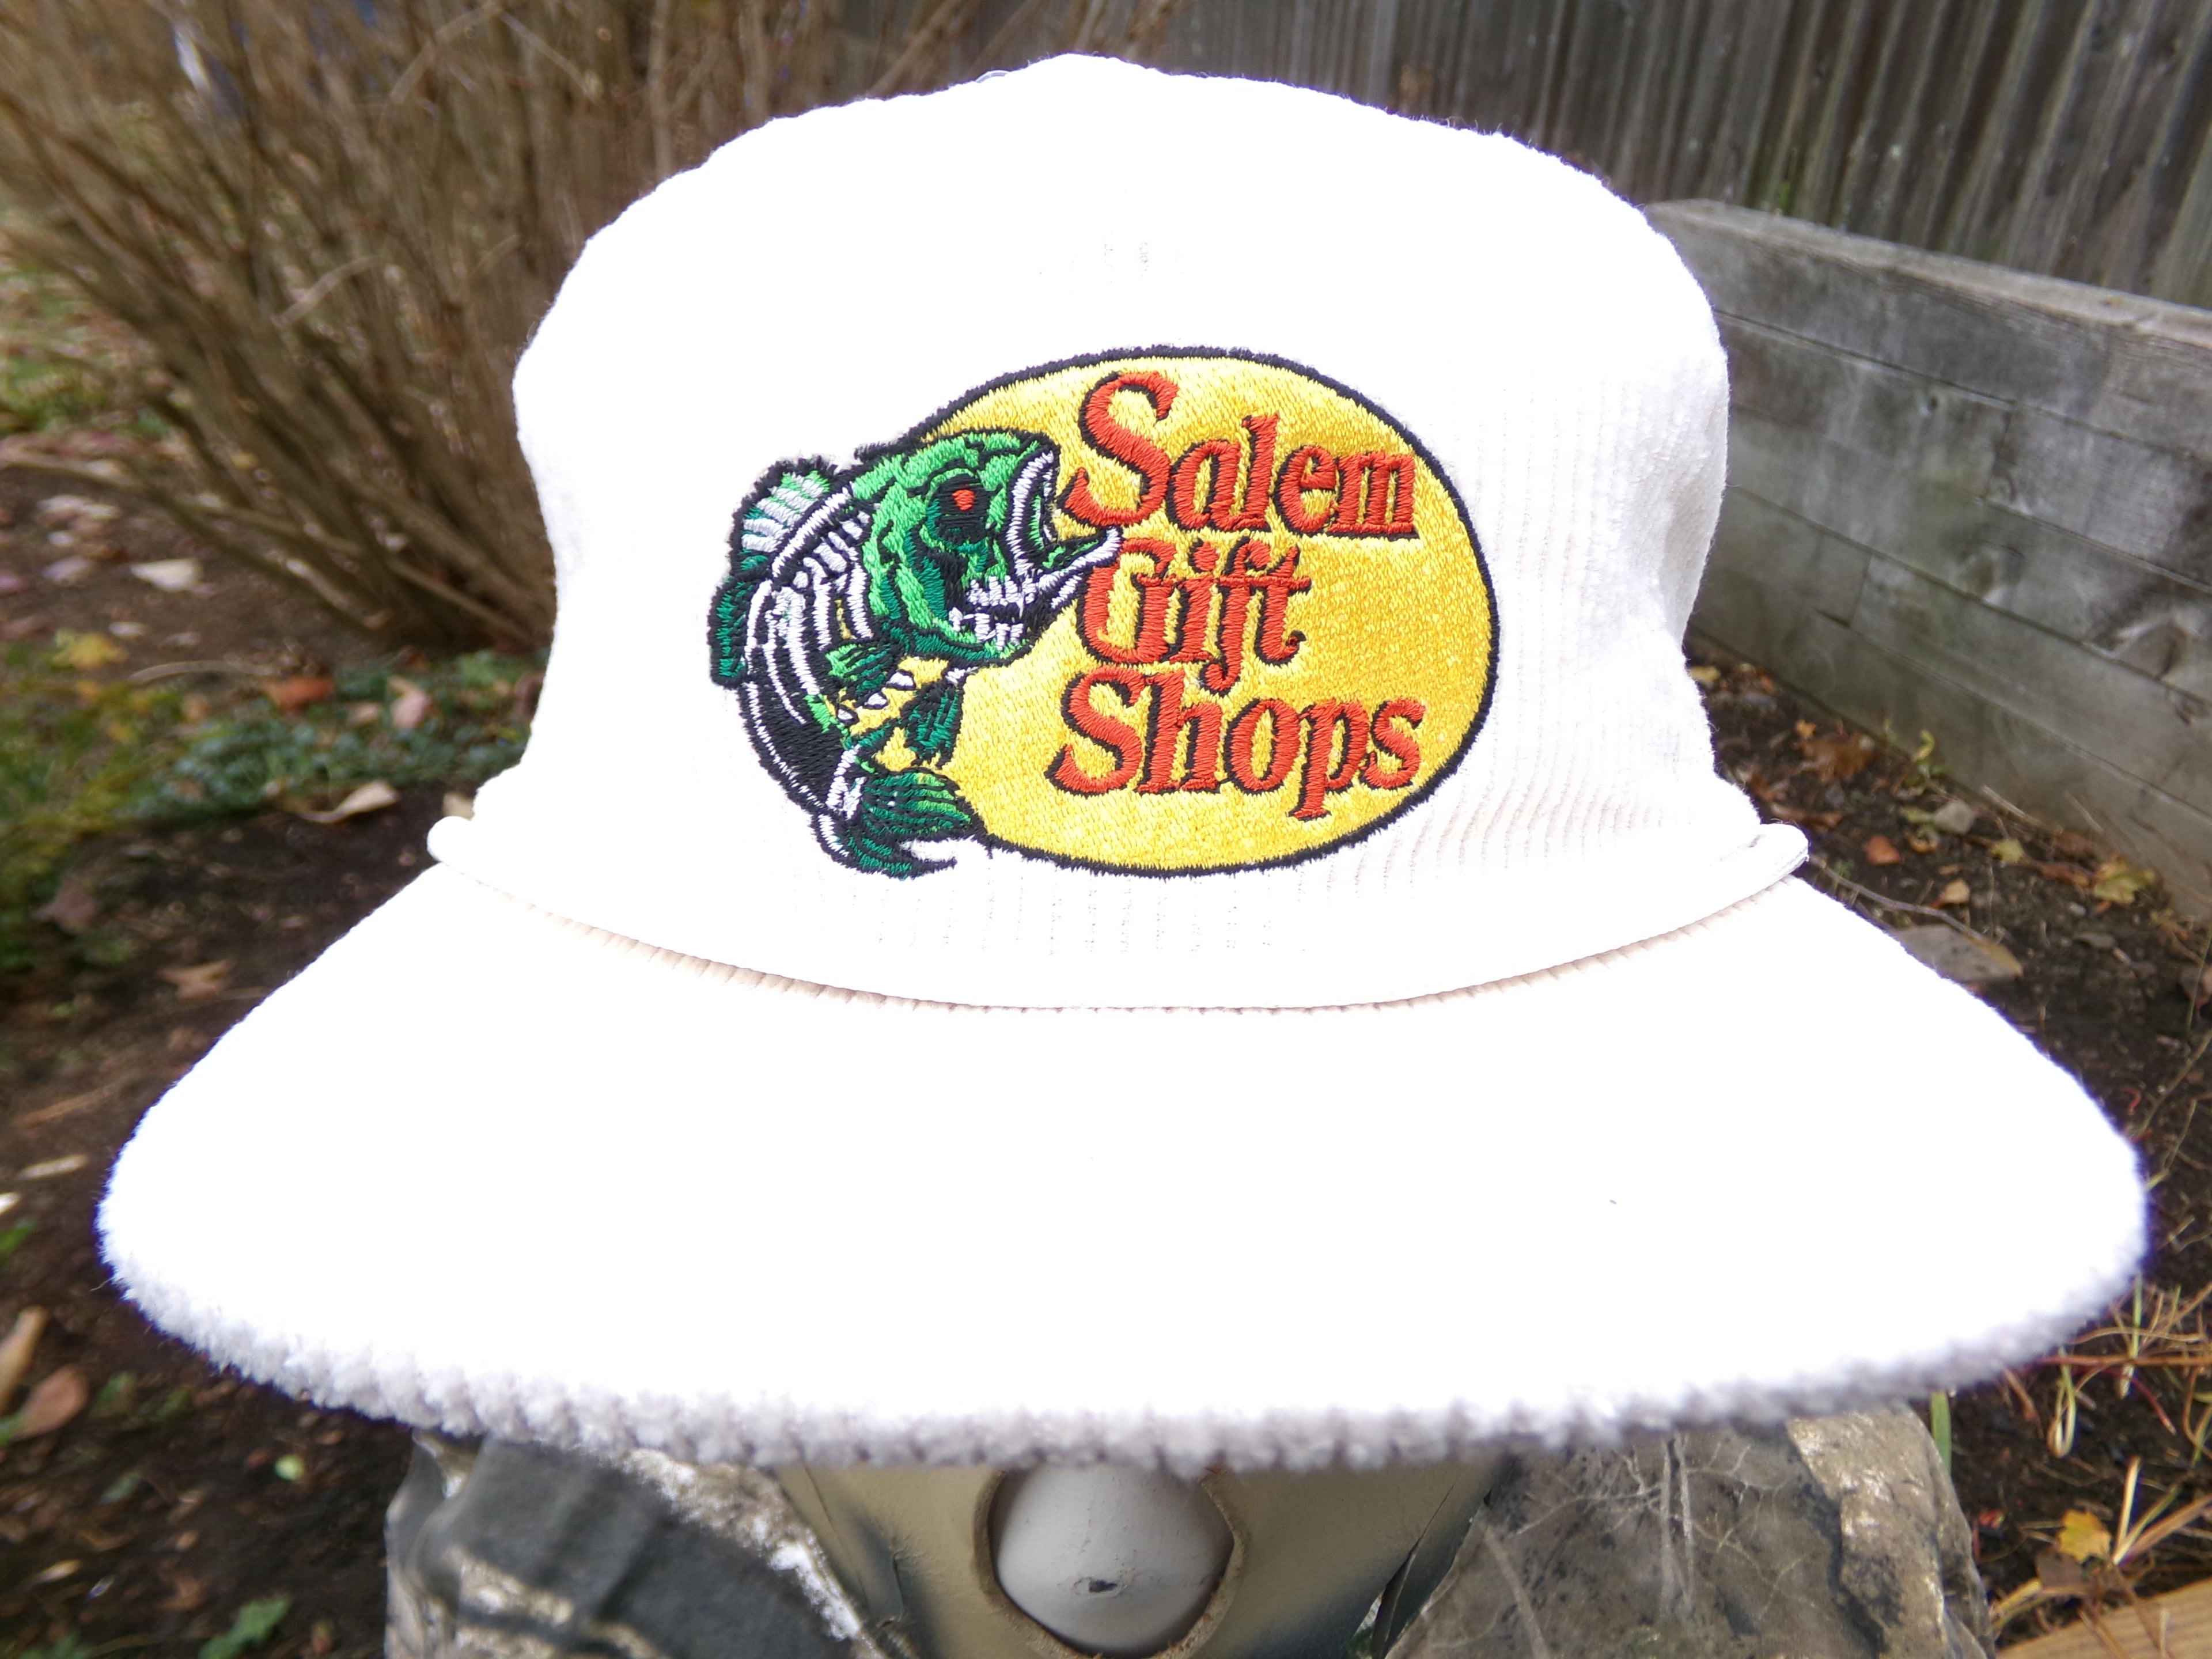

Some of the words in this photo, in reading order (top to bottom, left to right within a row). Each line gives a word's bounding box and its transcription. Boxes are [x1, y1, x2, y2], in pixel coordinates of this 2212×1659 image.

[1058, 371, 1419, 539] Salem
[1076, 537, 1312, 695] Gift
[1046, 666, 1426, 821] Shops
